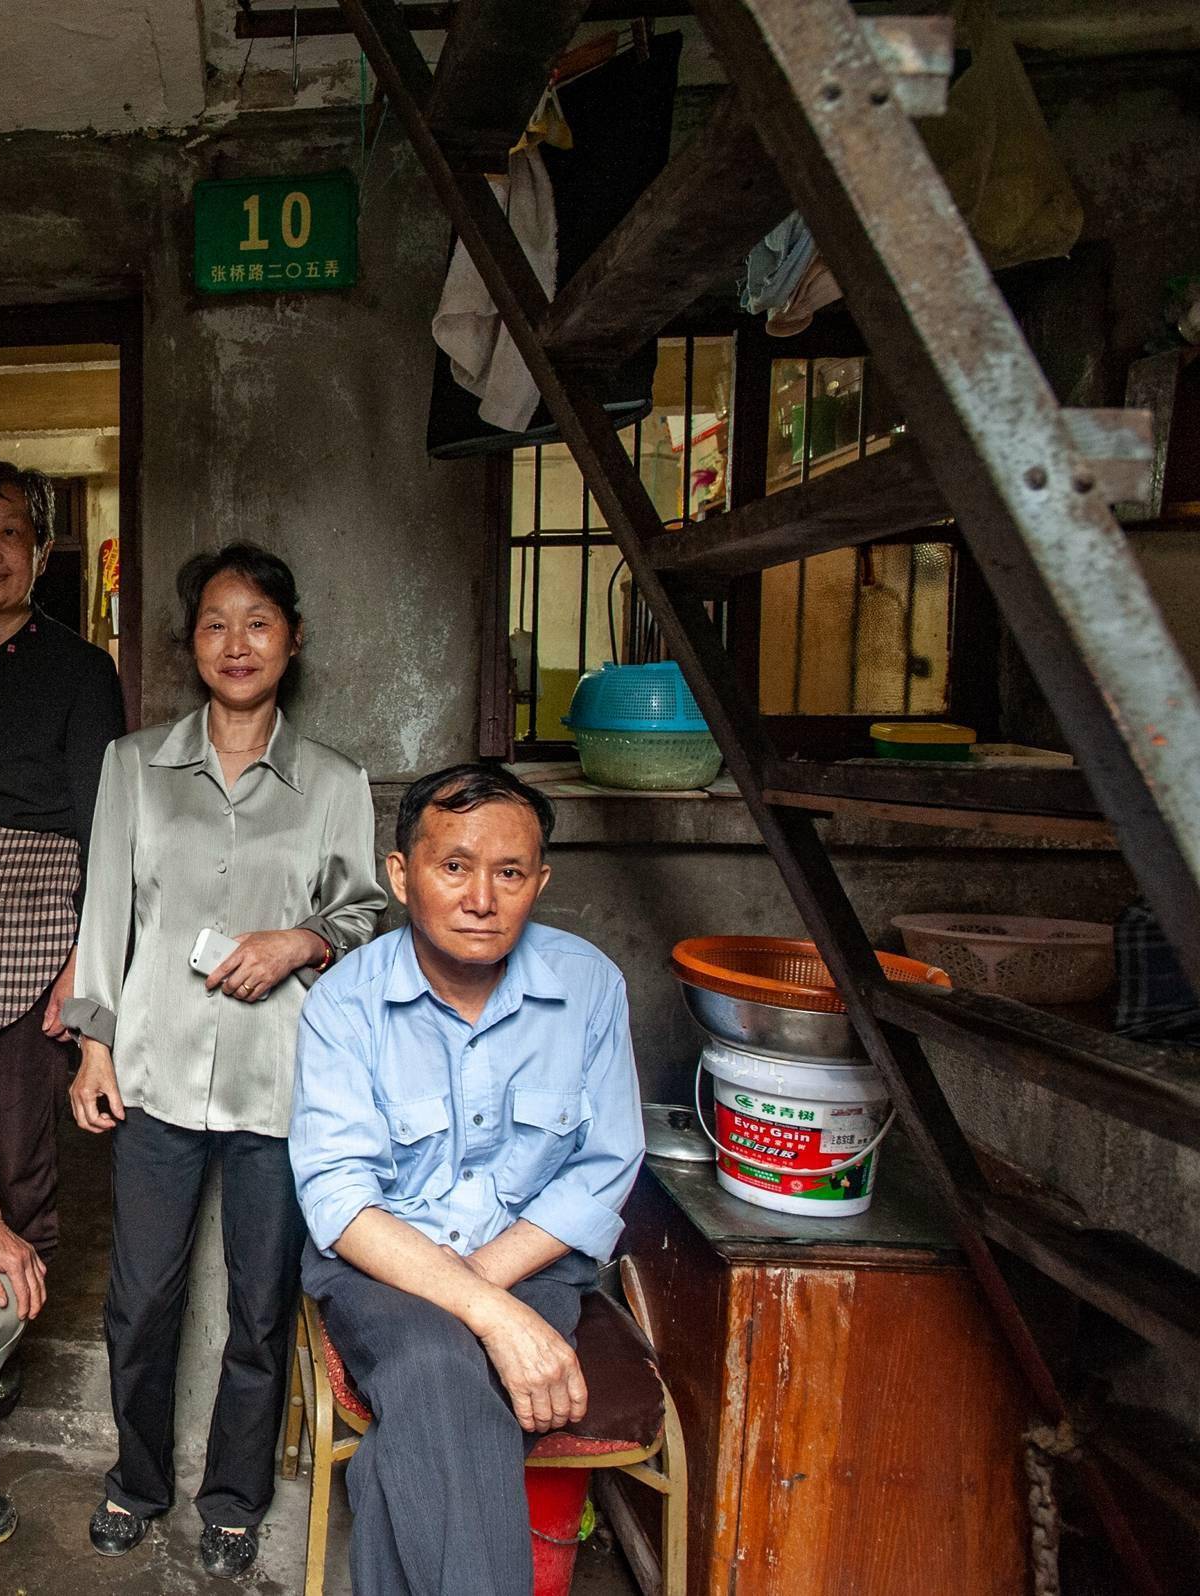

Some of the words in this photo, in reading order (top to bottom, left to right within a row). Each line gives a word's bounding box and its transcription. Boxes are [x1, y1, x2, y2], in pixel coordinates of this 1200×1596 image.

[239, 191, 312, 251] 10
[761, 1102, 815, 1121] 常青树
[734, 1115, 767, 1134] Ever
[770, 1127, 811, 1142] Gain
